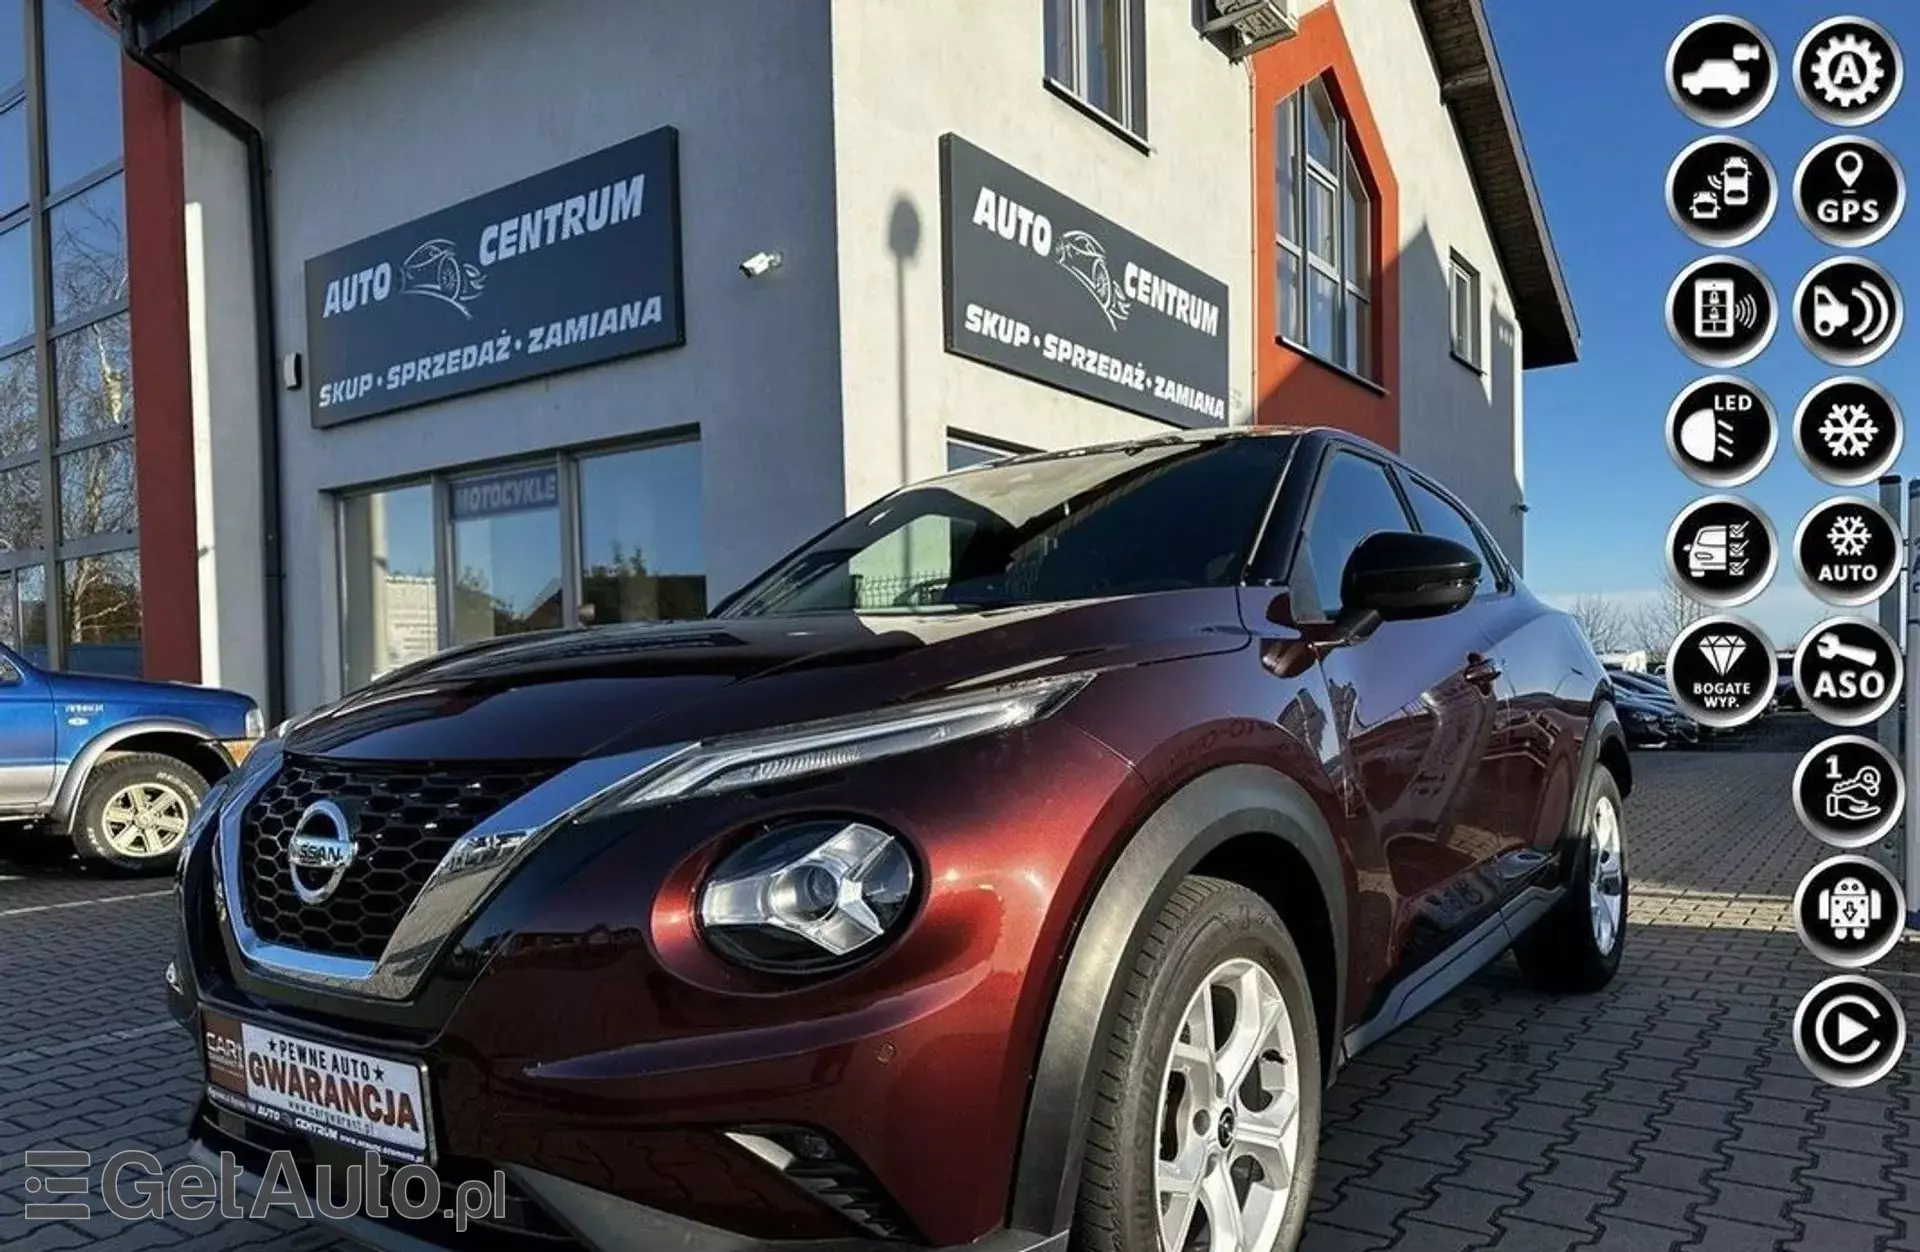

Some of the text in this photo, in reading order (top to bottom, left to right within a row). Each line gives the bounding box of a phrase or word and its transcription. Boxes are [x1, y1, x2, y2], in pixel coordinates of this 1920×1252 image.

[322, 174, 645, 318] AUTO CENTRUM
[973, 186, 1220, 337] AUTO CENTRUM
[318, 296, 663, 408] SKUP SPRZEDAŻ ZAMIANA
[964, 303, 1225, 420] SKUP SPRZEDAŻ ZAMIANA
[455, 473, 557, 511] MOTOCYKLE
[249, 1051, 419, 1132] GWARANCJA
[279, 1039, 326, 1073] PEWNE
[331, 1053, 370, 1081] AUTO
